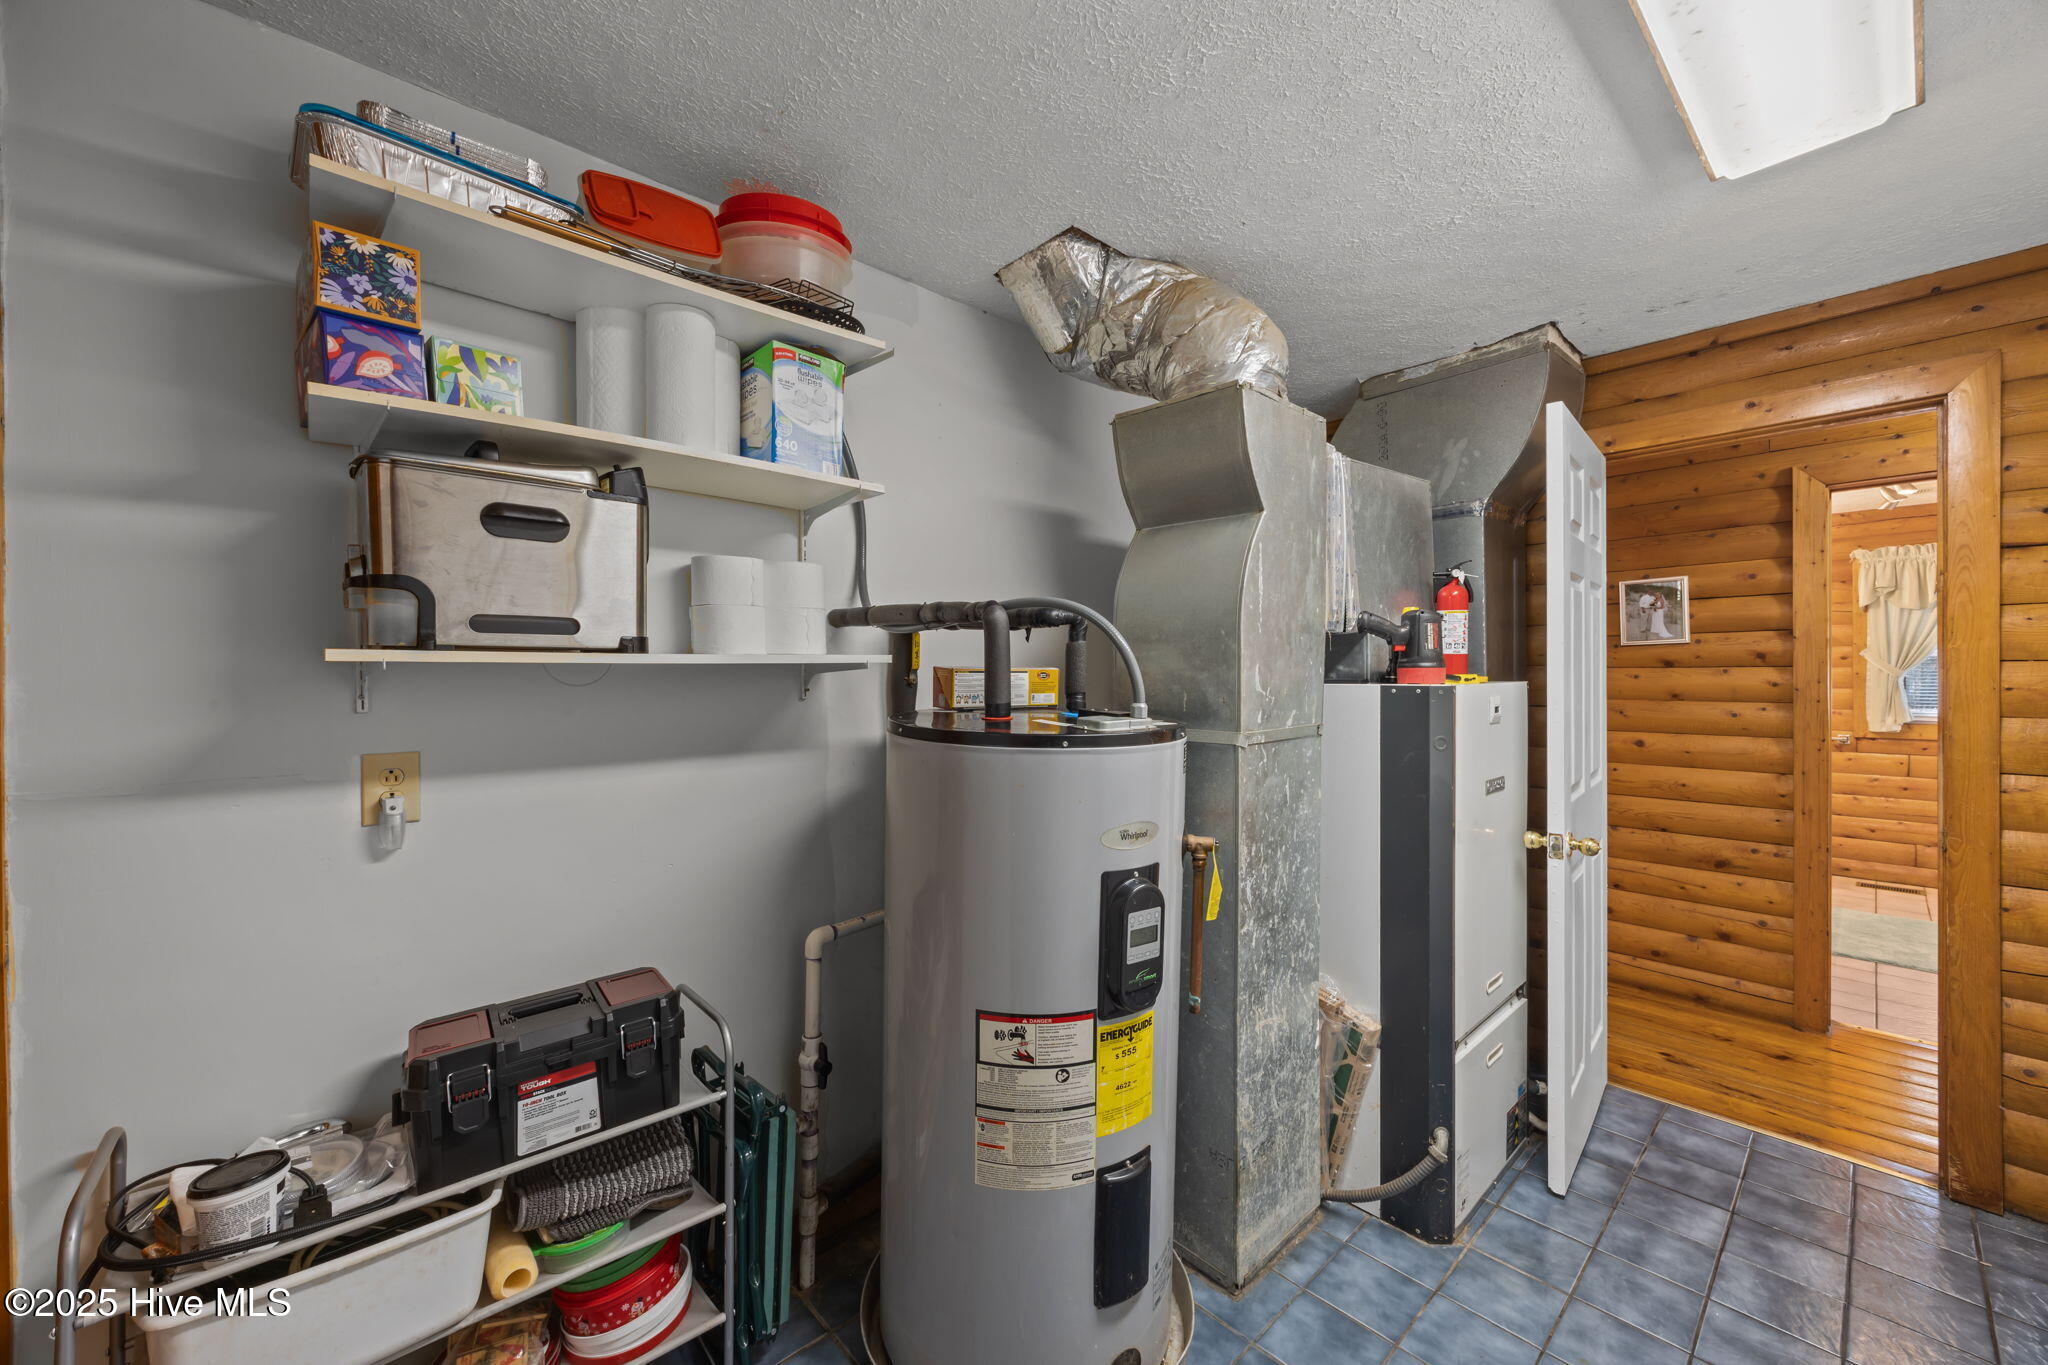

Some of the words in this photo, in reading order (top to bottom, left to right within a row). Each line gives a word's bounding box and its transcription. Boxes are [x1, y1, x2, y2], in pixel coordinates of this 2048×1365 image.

[797, 375, 823, 388] wipes
[775, 436, 798, 452] 640
[1119, 829, 1149, 841] Whirlpool
[1029, 1017, 1052, 1025] DANGER
[1100, 1016, 1152, 1042] ENERGYGUIDE
[1121, 1046, 1137, 1058] 555
[521, 1078, 552, 1091] TOUGH
